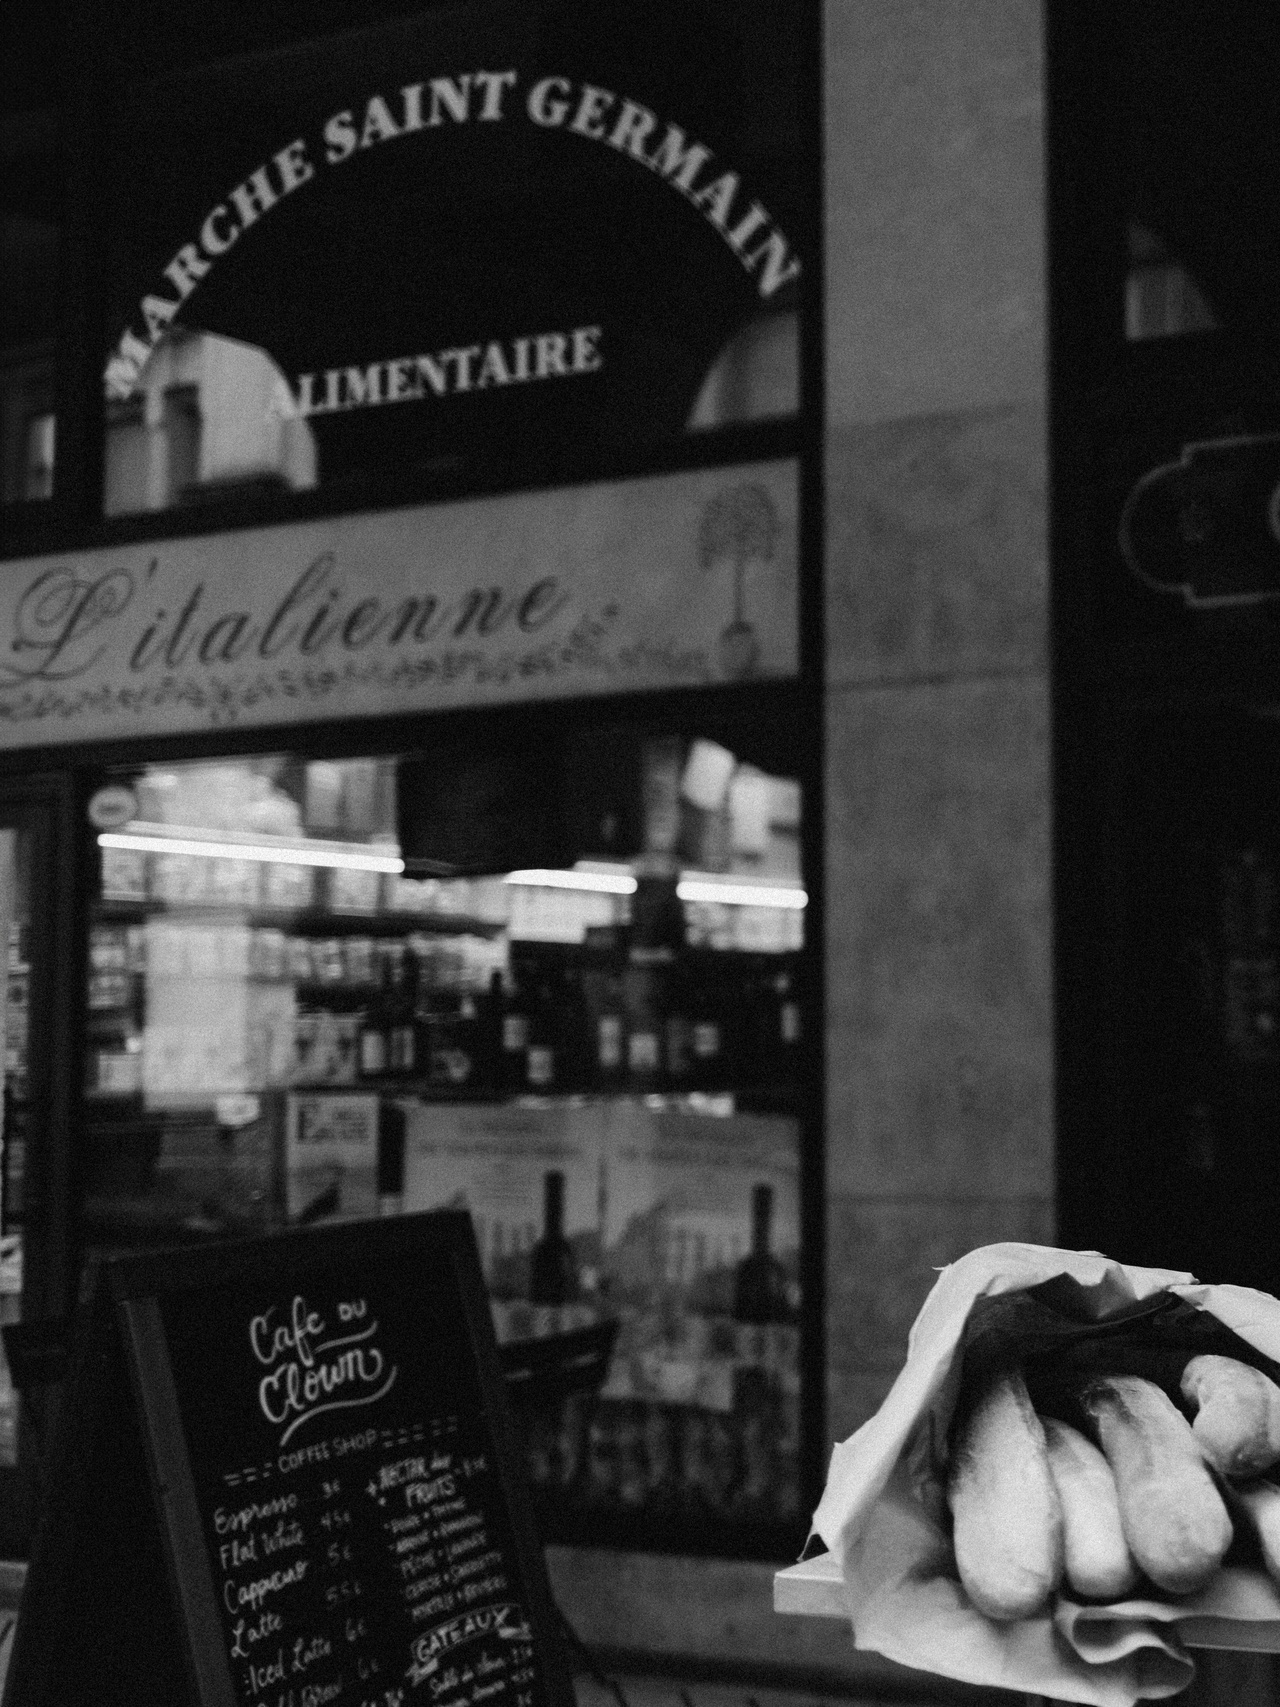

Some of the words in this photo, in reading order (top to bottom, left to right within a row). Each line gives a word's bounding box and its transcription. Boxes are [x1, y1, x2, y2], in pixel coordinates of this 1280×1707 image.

[104, 138, 316, 400] MARCHE
[322, 69, 517, 165] SAINT
[526, 75, 802, 299] GERMAIN
[258, 1348, 384, 1424] Clown
[277, 1440, 330, 1474] COFFEE
[332, 1428, 377, 1457] SHOP
[213, 1492, 298, 1535] Espresso
[219, 1532, 258, 1571] Flat
[230, 1616, 283, 1659] Latte
[416, 1605, 511, 1663] GATEAUX
